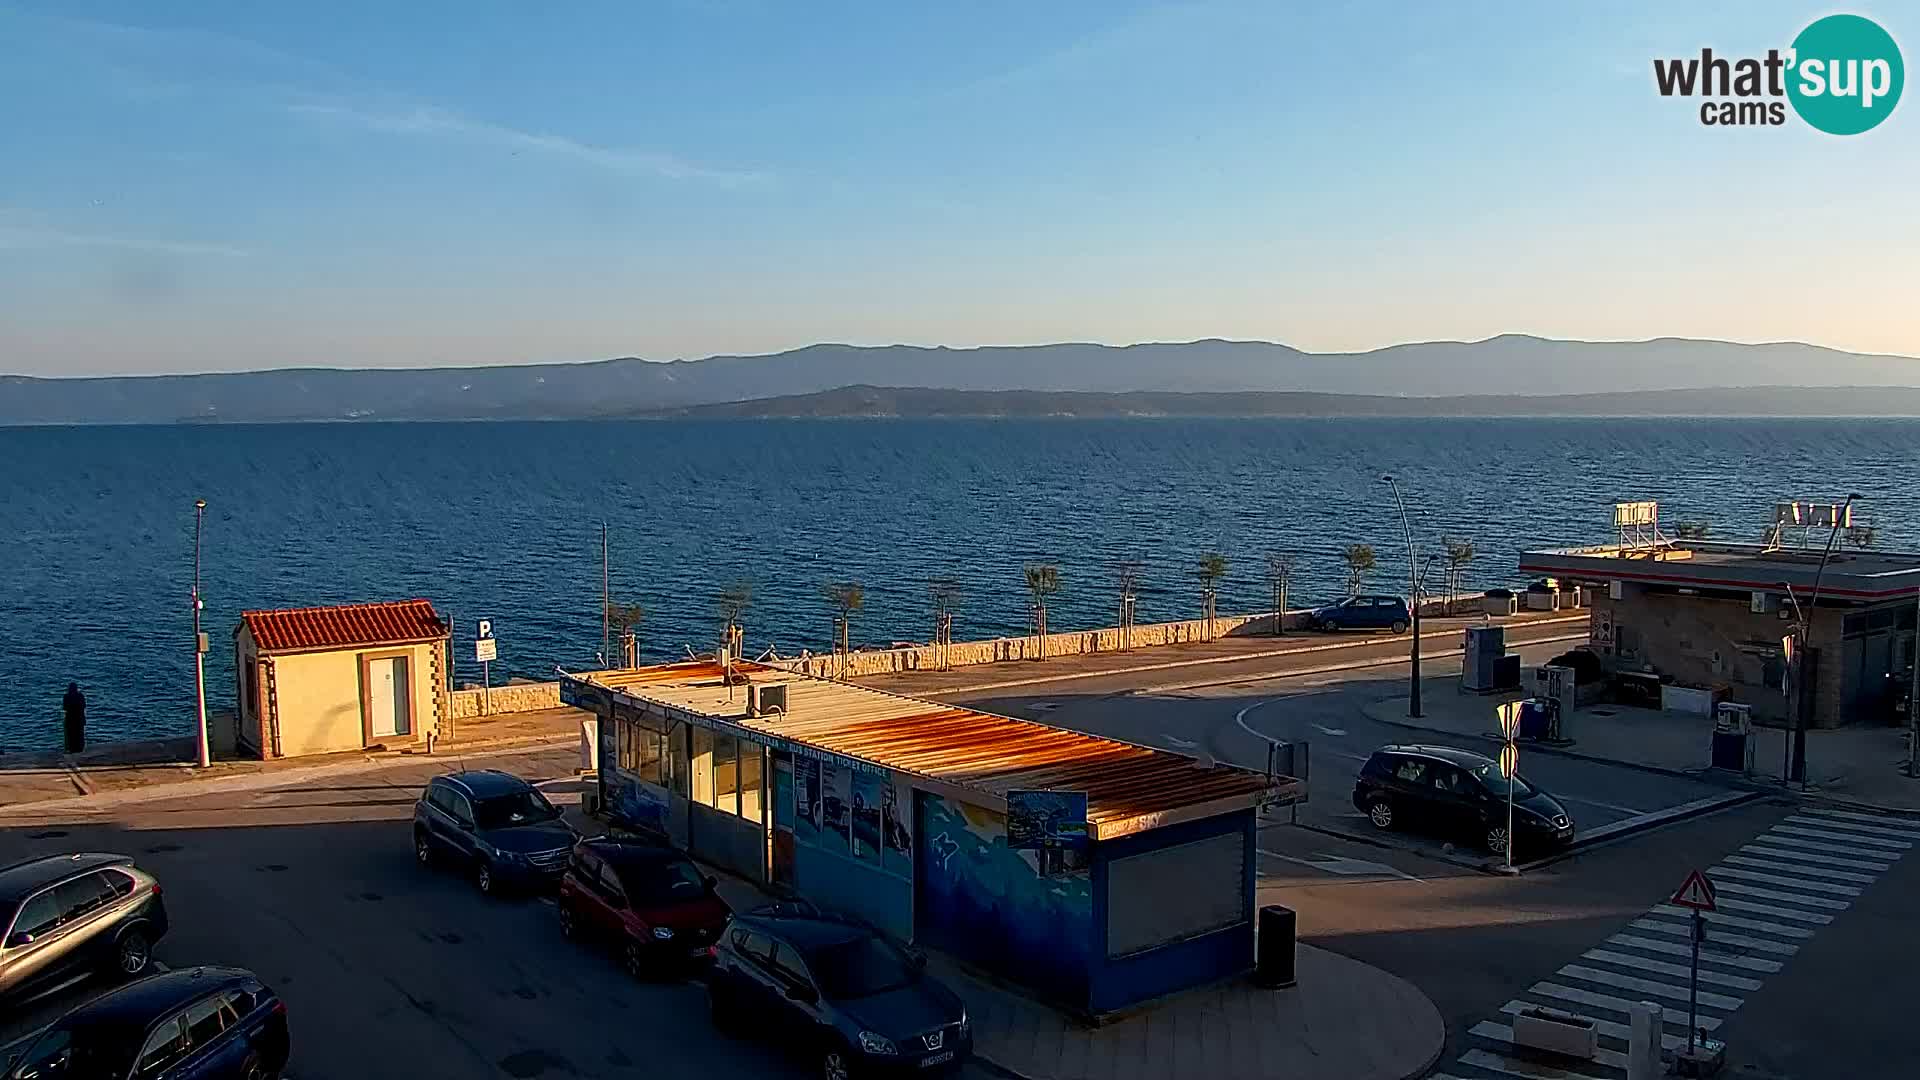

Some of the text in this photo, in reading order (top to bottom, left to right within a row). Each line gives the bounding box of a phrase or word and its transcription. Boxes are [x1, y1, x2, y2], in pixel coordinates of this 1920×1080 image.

[479, 620, 491, 638] P
[789, 740, 803, 754] BUS
[803, 747, 834, 764] STATION
[836, 756, 860, 771] TICKET
[861, 762, 887, 777] OFFICE
